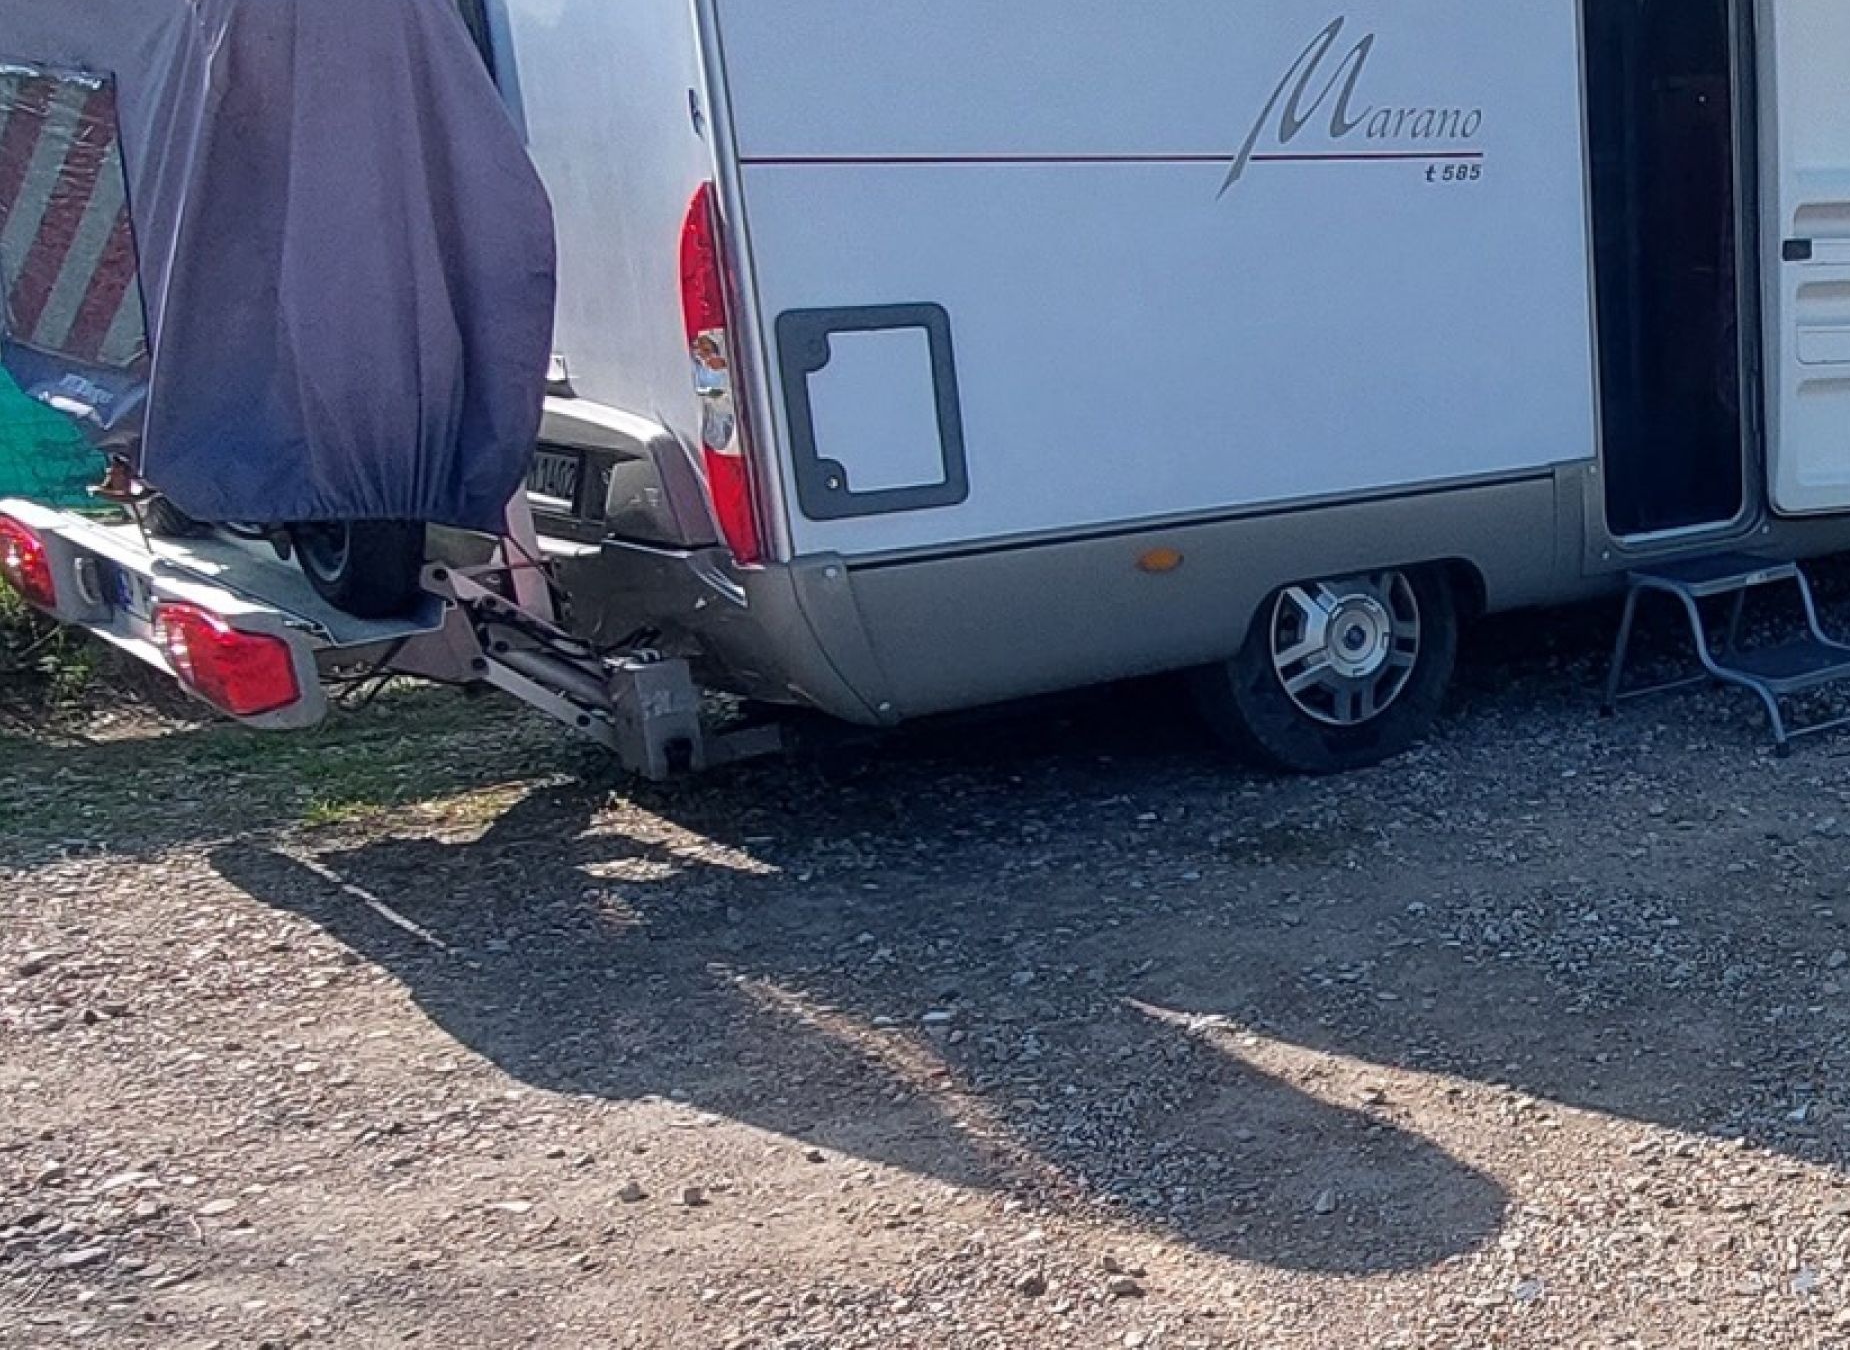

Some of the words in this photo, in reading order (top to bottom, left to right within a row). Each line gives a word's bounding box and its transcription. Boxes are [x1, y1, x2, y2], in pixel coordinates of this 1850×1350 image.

[1215, 15, 1482, 201] Marano
[1424, 163, 1436, 182] t
[1442, 163, 1482, 181] 585
